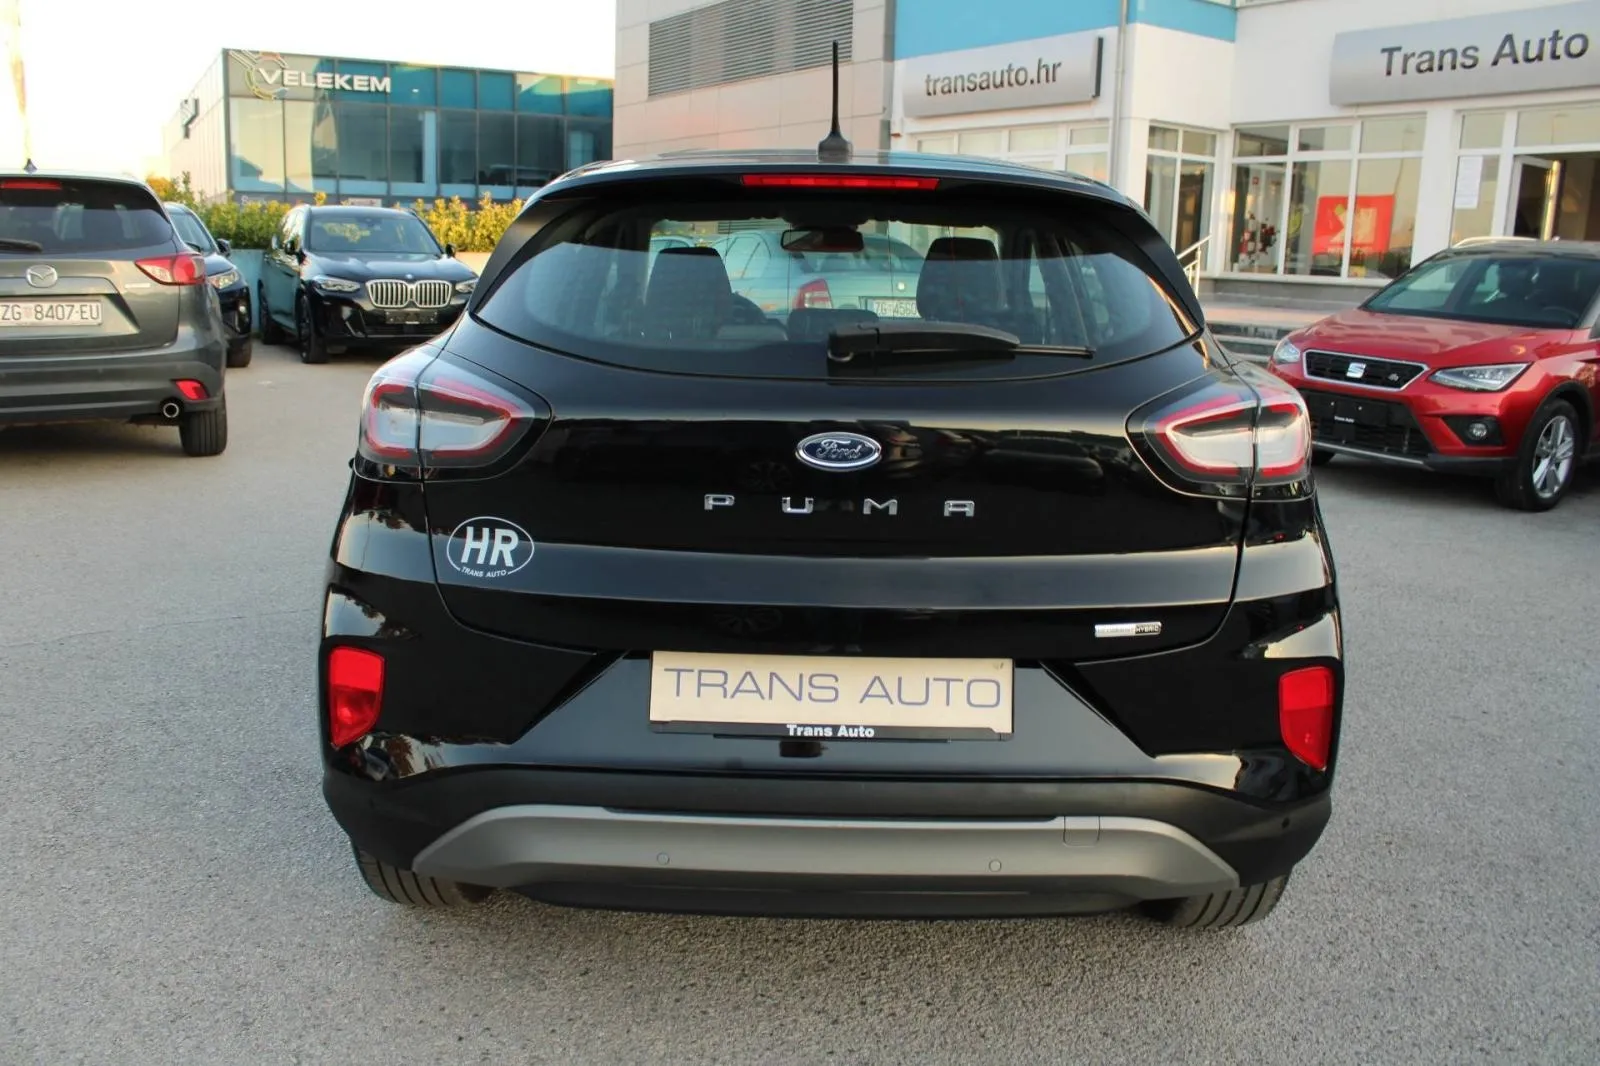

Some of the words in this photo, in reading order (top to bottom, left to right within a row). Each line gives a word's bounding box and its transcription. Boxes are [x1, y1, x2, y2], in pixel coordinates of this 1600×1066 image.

[1381, 45, 1480, 77] Trans
[1491, 29, 1590, 67] Auto
[259, 67, 391, 93] VELEKEM
[925, 58, 1062, 97] transauto.hr
[816, 439, 862, 459] Ford
[704, 494, 975, 517] PUMA
[461, 526, 519, 567] HR
[461, 566, 484, 578] TRANS
[485, 569, 507, 578] AUTO
[664, 668, 839, 702] TRANS
[859, 676, 1001, 708] AUTO
[786, 723, 833, 737] Trans
[837, 725, 875, 738] Auto
